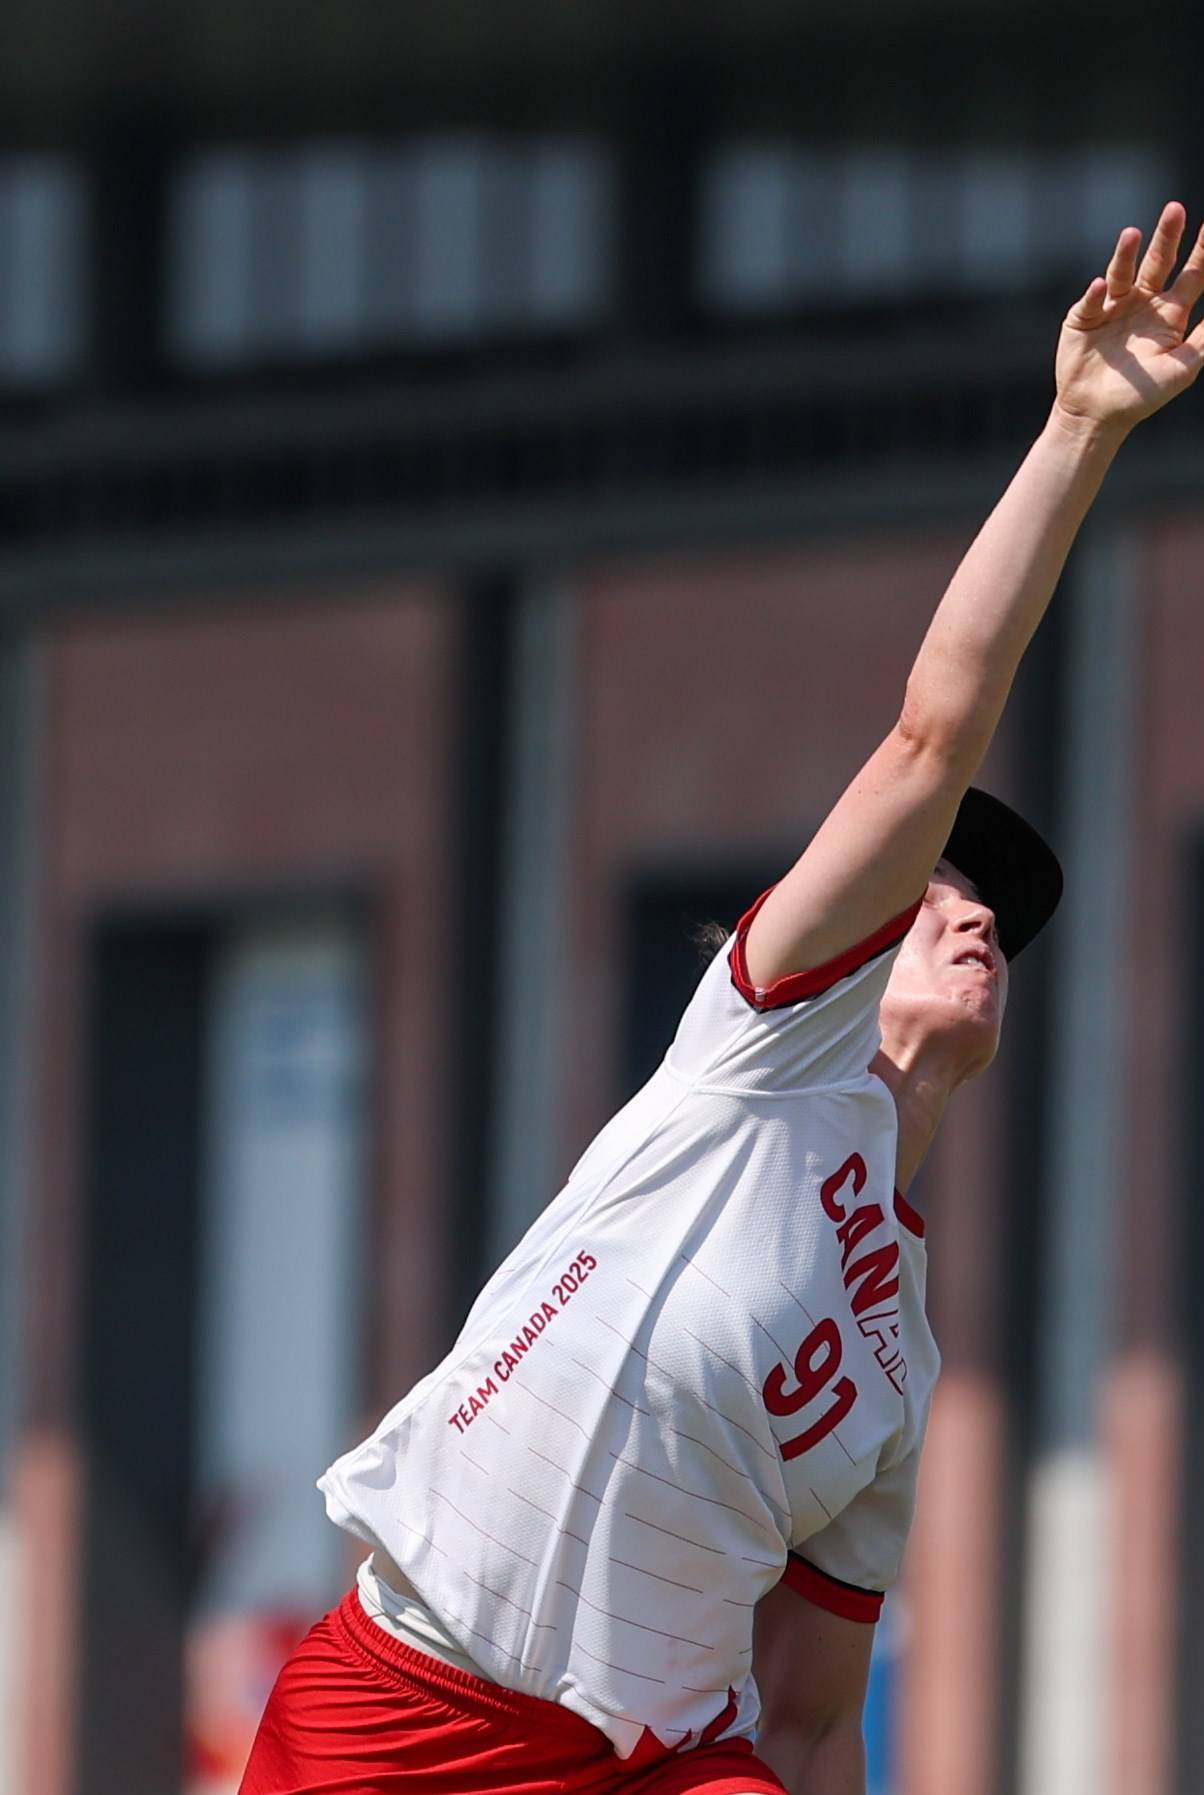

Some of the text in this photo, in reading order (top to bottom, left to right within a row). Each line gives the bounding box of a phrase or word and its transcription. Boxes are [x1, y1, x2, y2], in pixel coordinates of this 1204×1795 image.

[448, 1250, 597, 1434] TEAM CANADA 2025
[762, 1317, 858, 1462] 91
